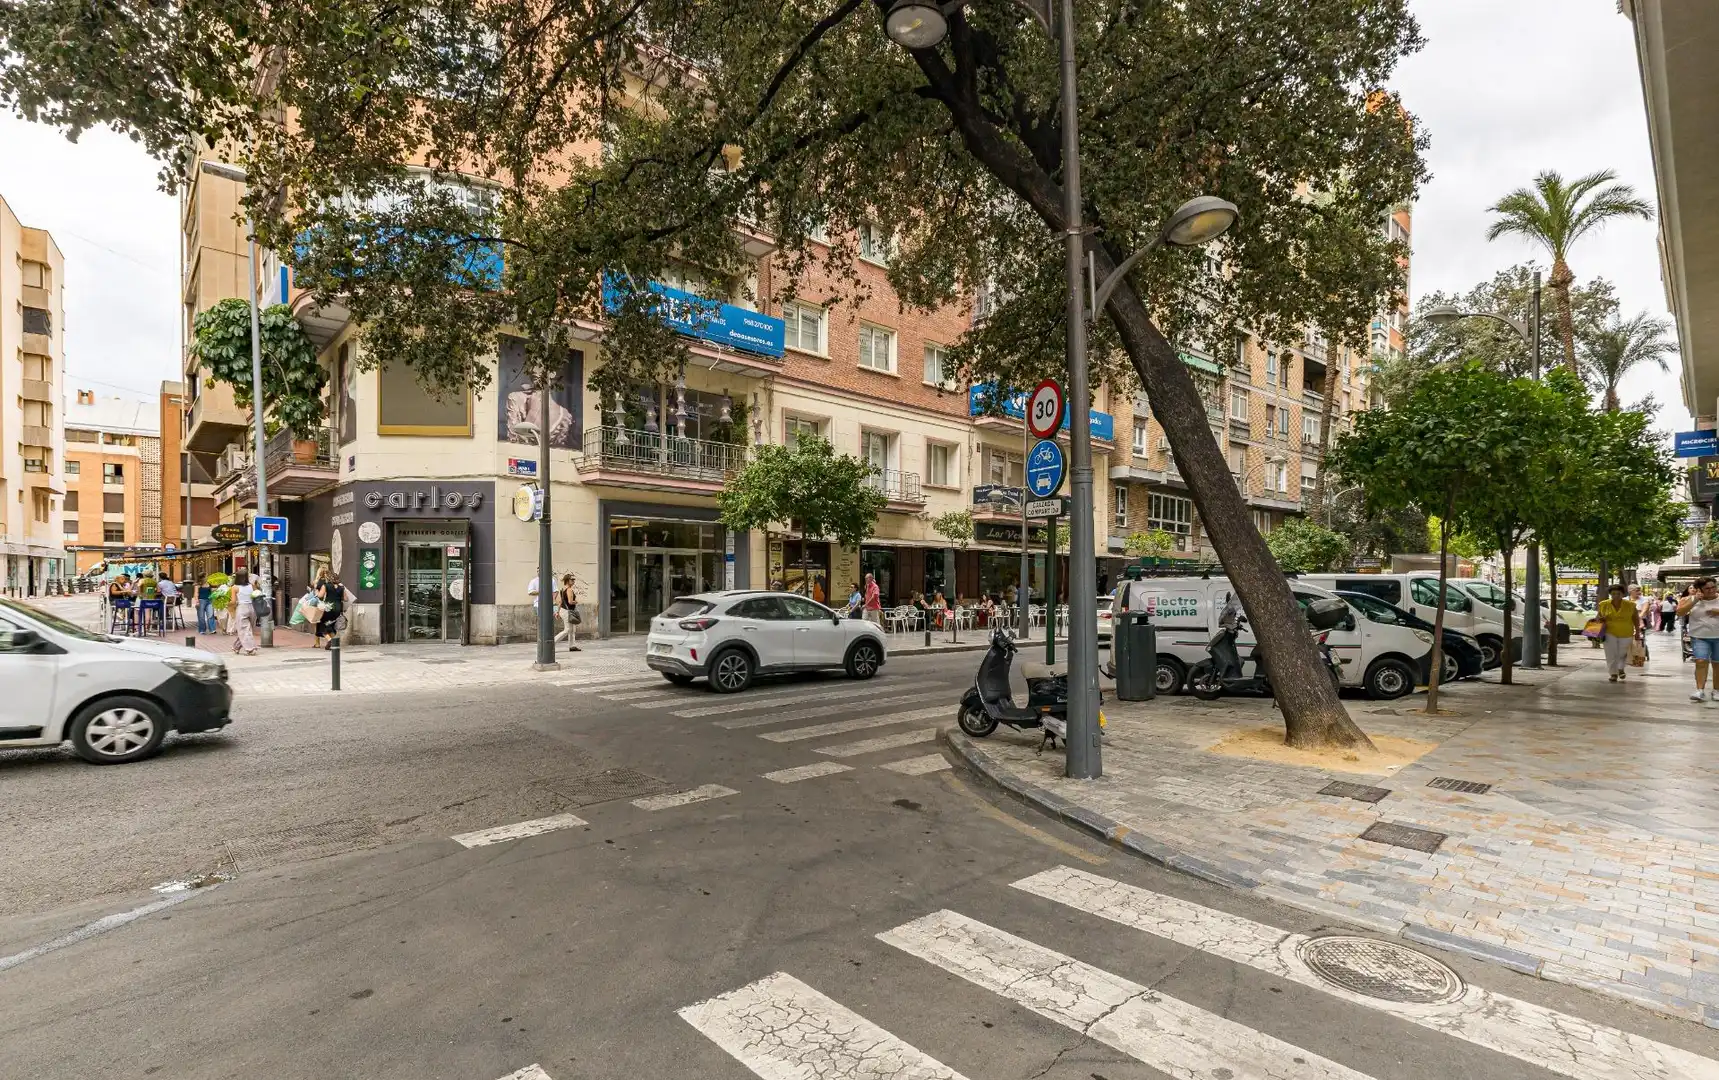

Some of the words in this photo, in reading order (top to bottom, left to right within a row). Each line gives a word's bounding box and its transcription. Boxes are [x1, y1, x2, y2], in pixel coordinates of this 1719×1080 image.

[1035, 399, 1055, 420] 30
[364, 486, 482, 509] carlos
[1032, 501, 1055, 509] CALZADA
[1147, 596, 1198, 606] Electro
[1146, 606, 1198, 618] Espuña
